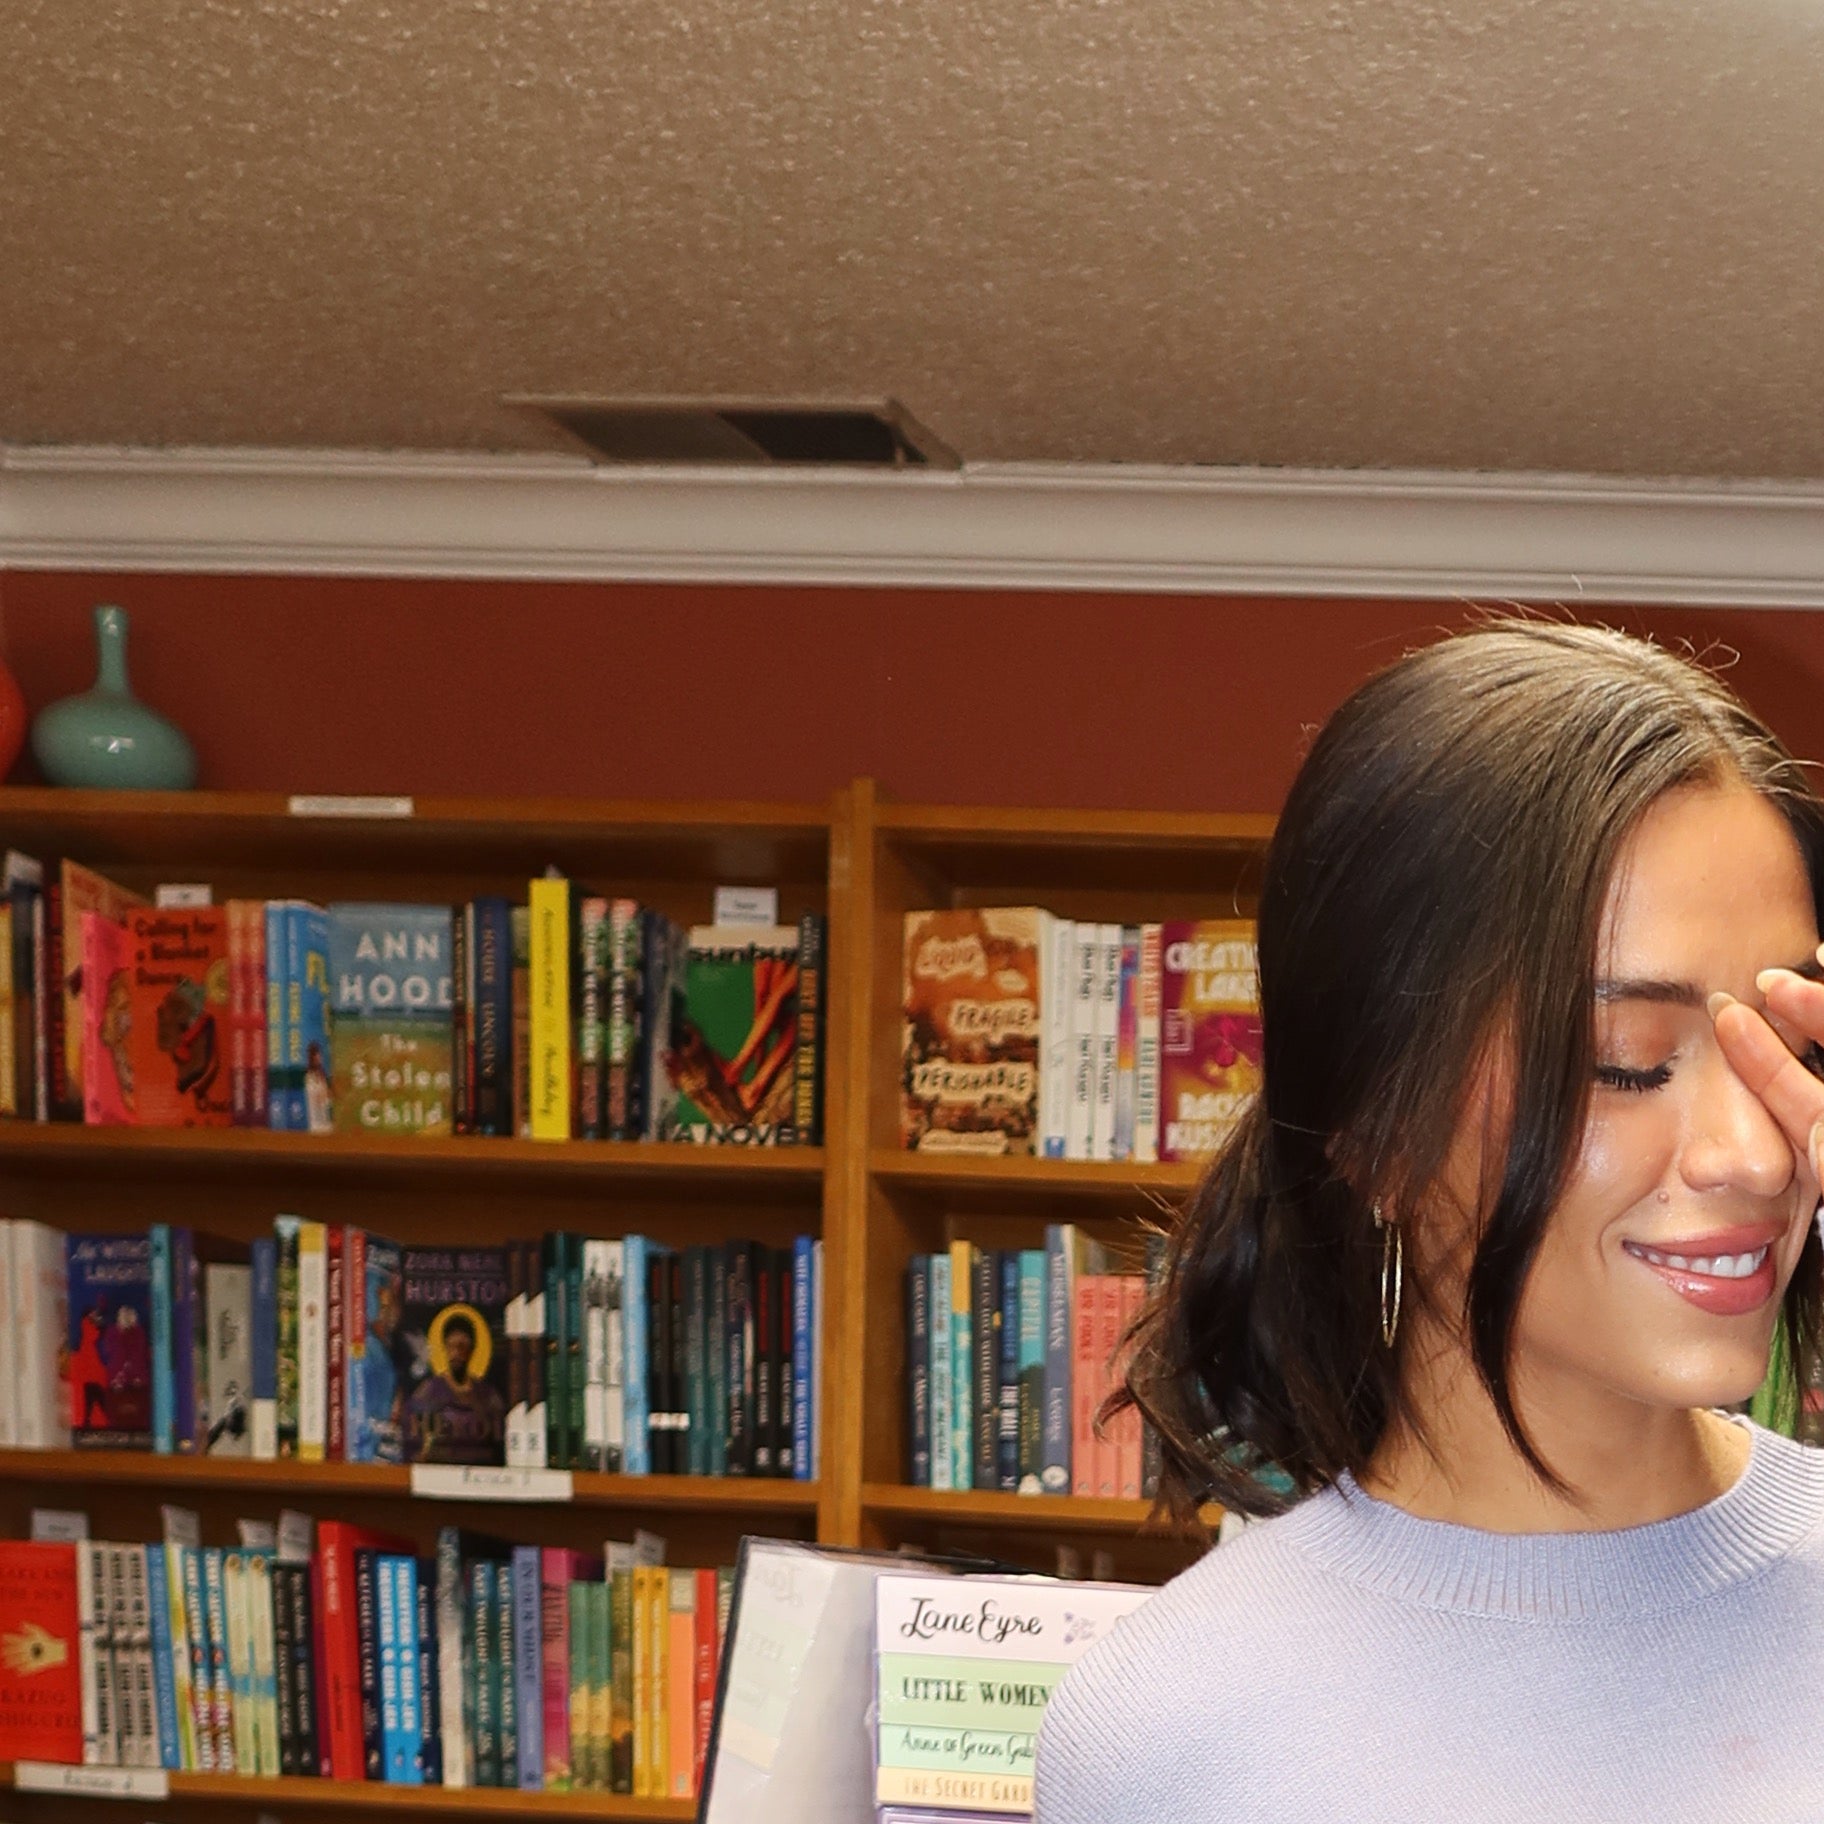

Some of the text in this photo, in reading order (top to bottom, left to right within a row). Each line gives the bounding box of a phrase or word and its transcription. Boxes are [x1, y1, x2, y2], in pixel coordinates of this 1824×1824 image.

[356, 931, 440, 961] ANN
[351, 1060, 452, 1089] Stolen
[361, 1100, 443, 1127] Child
[901, 1597, 1042, 1642] Jane Eyre
[902, 1676, 1053, 1706] LITTLE WOMEN
[901, 1726, 1001, 1762] Anne Green
[934, 1776, 984, 1798] SECRET
